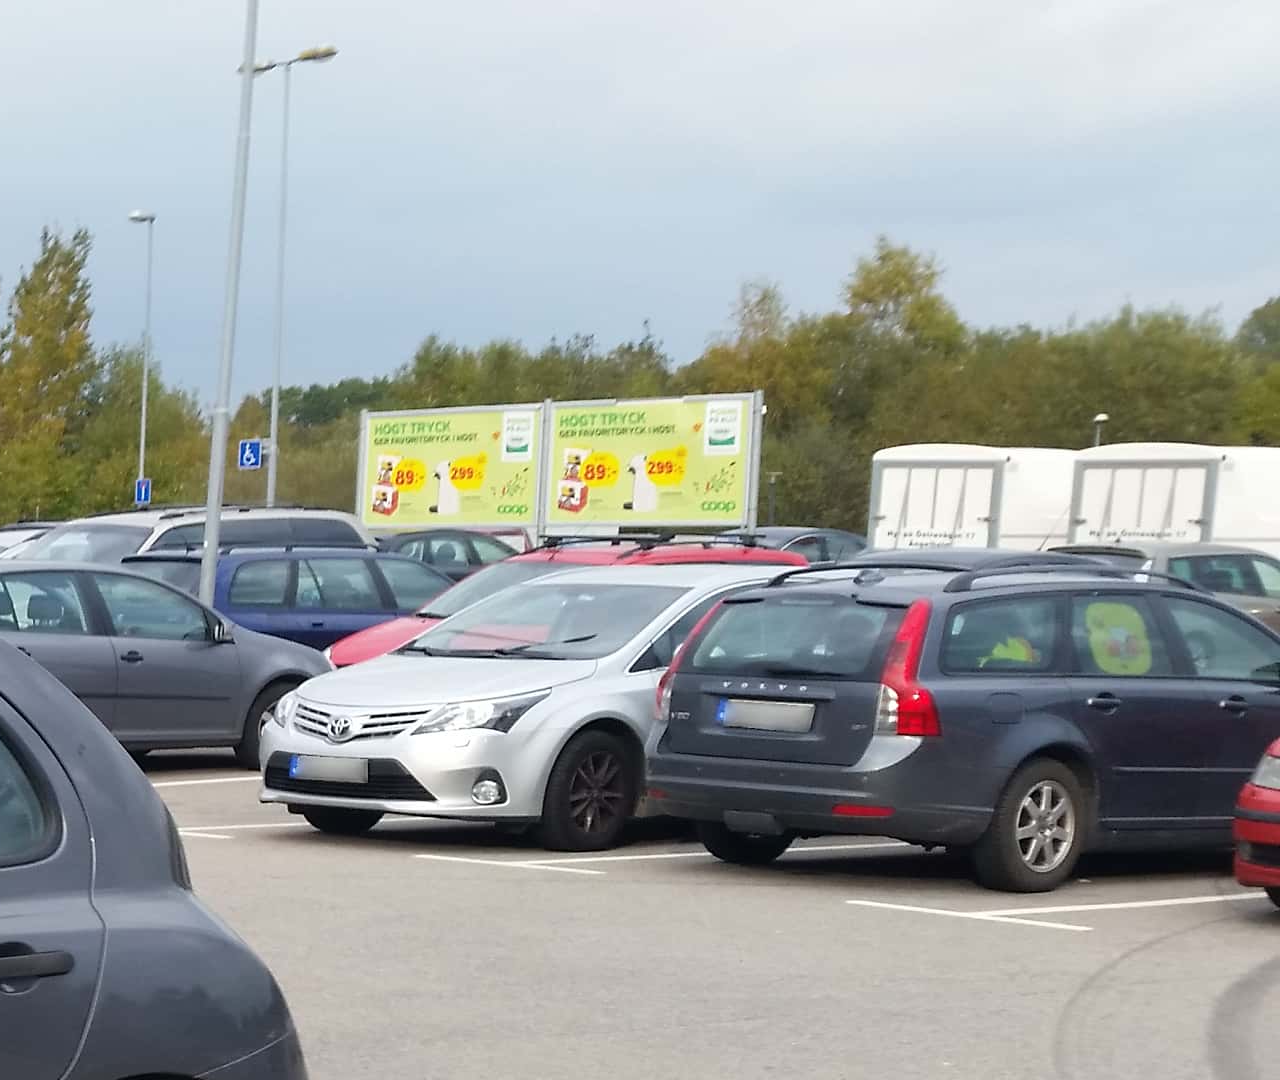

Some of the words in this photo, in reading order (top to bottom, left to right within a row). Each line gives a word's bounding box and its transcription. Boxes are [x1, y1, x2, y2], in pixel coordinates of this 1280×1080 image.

[497, 504, 528, 516] coop
[702, 501, 736, 512] coop
[723, 681, 808, 692] VOLVO
